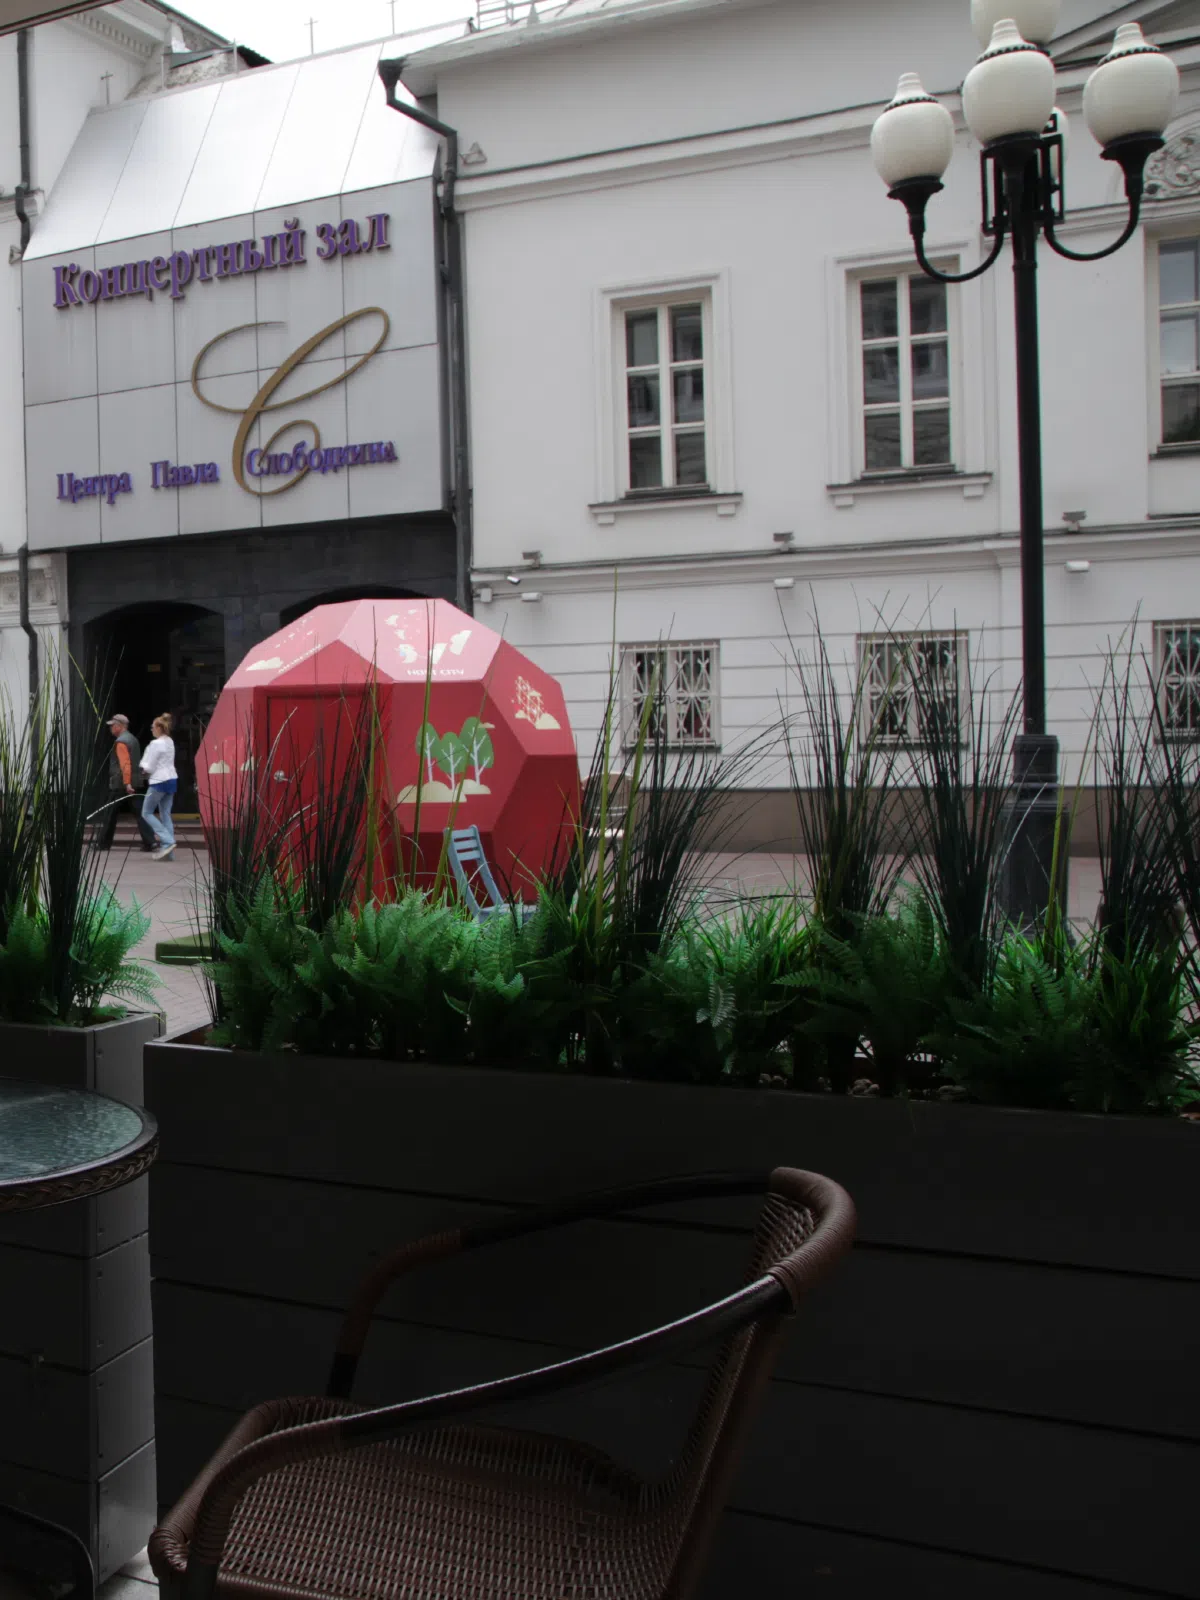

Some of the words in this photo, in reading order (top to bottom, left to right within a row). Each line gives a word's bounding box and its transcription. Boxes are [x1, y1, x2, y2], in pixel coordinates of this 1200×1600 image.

[52, 217, 306, 309] Концертный
[315, 213, 390, 260] зал
[56, 471, 132, 504] Центра
[150, 460, 220, 489] Павла
[245, 440, 398, 477] Слободкина
